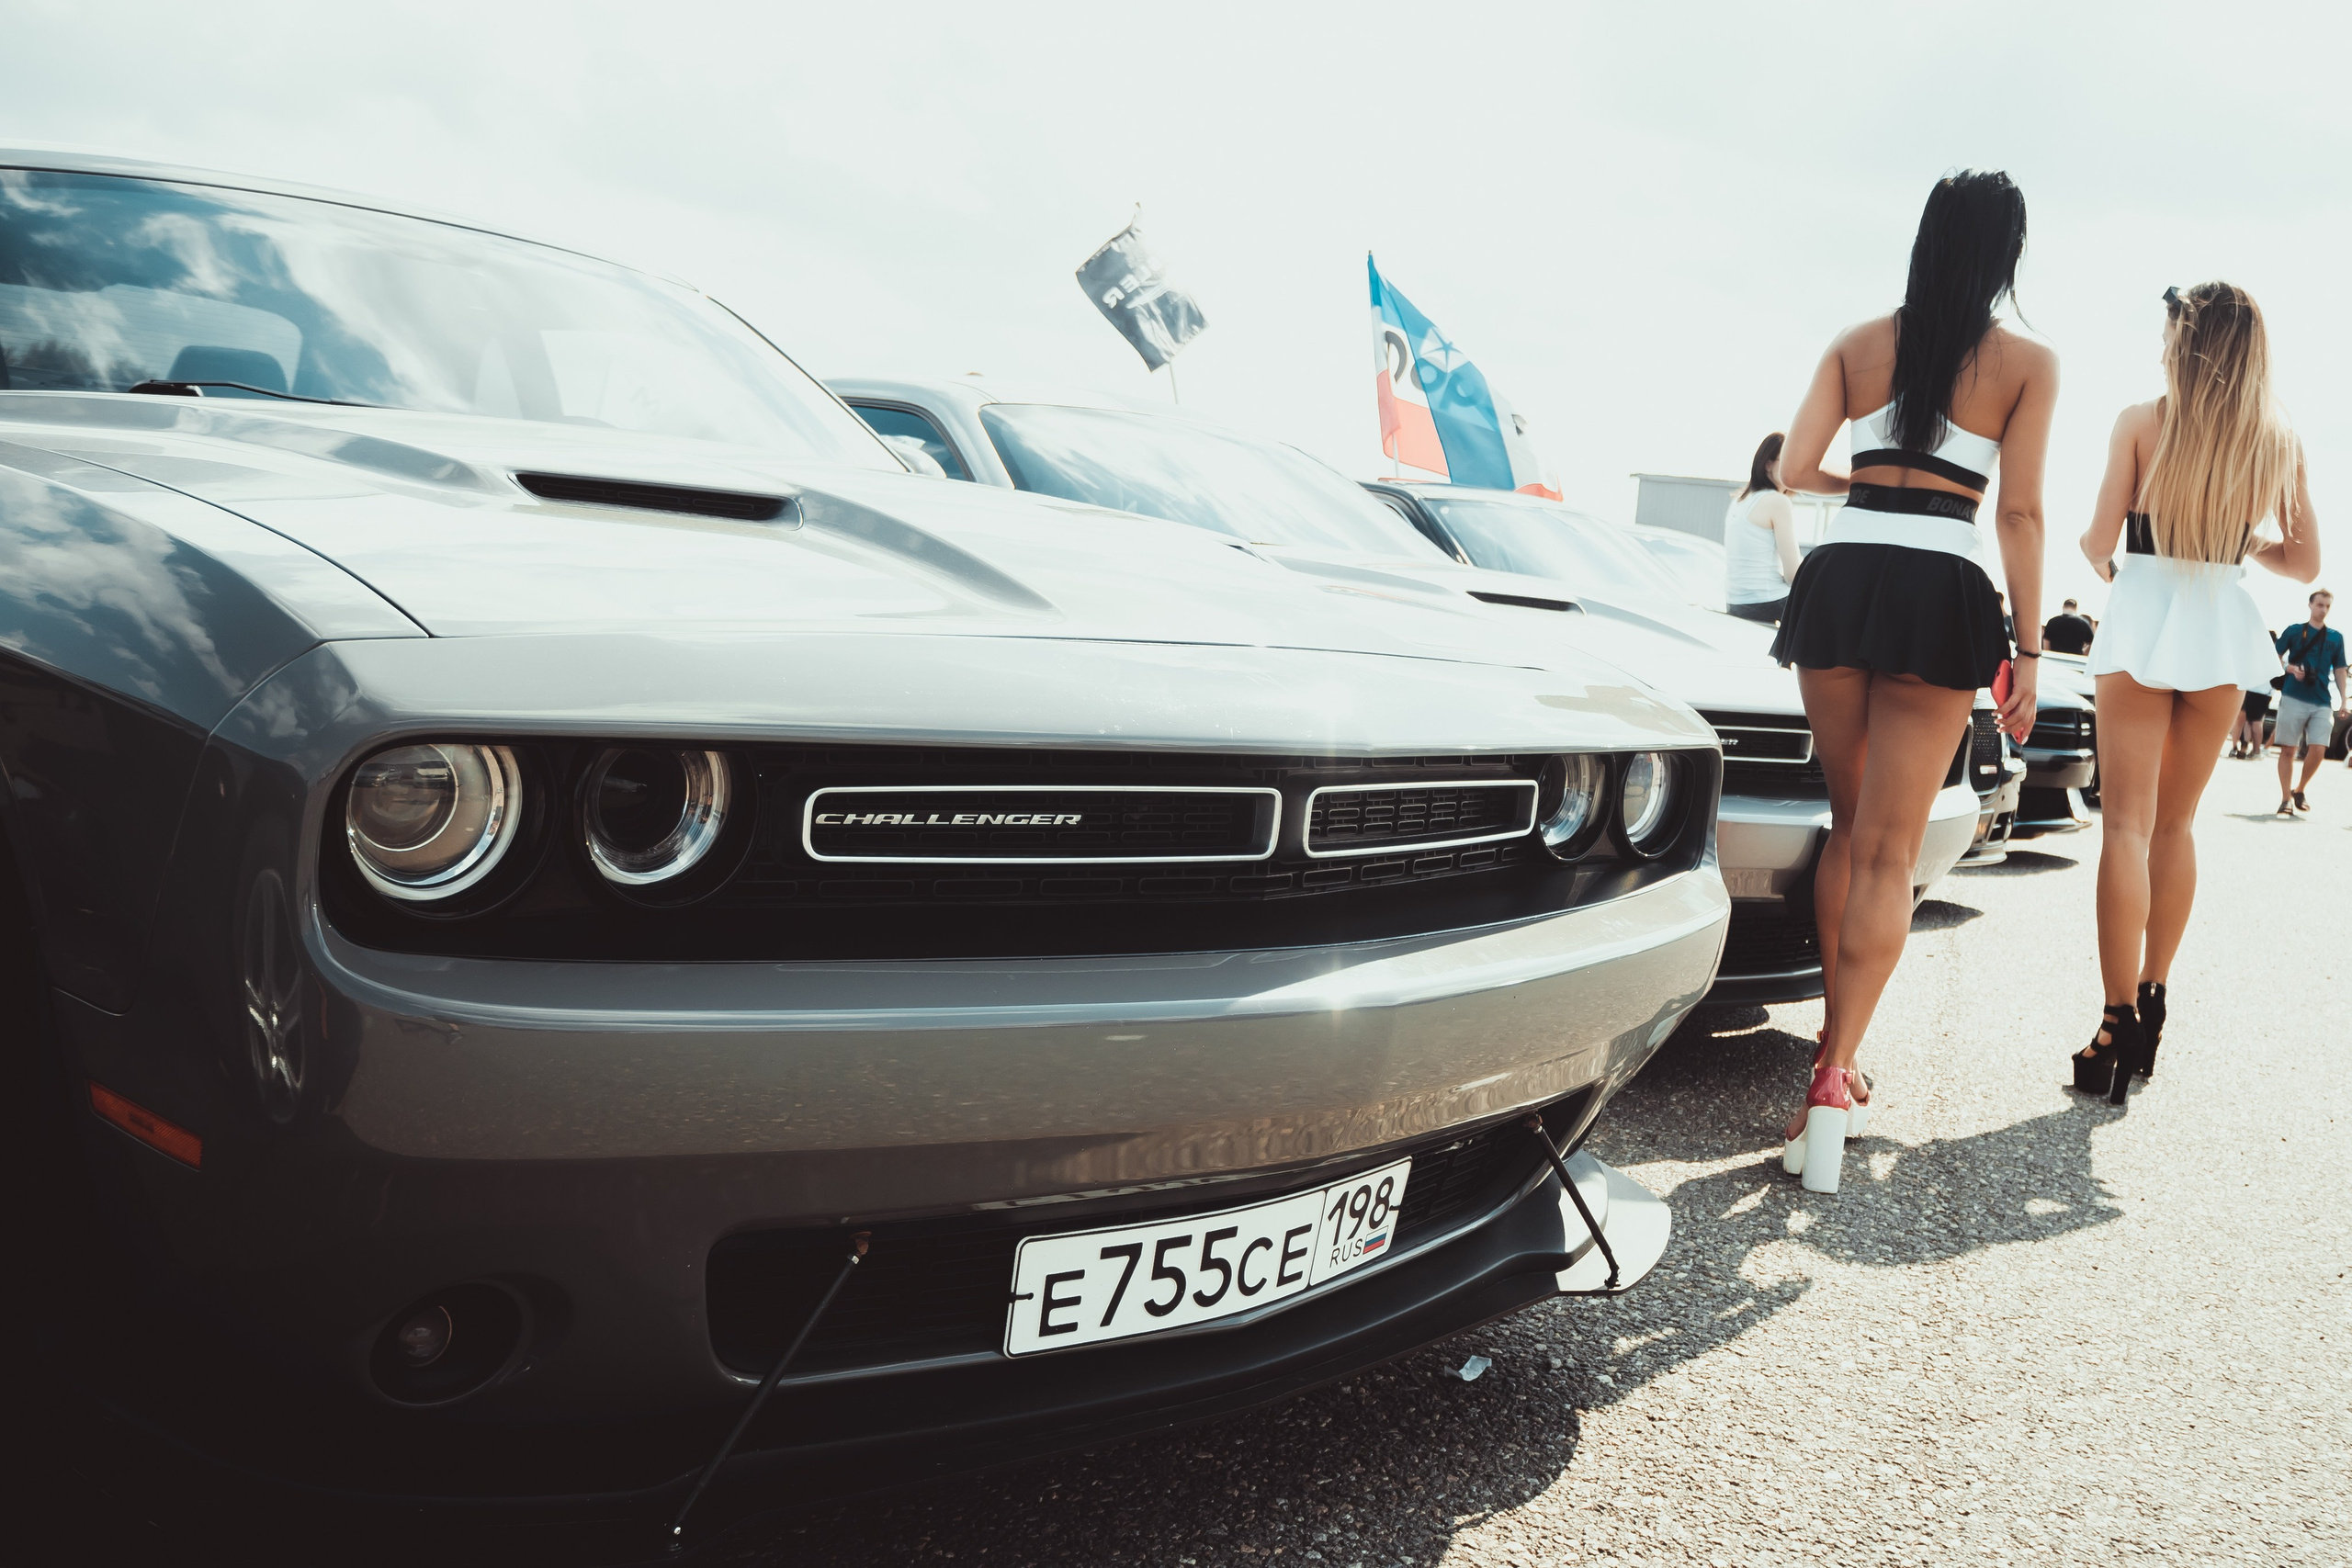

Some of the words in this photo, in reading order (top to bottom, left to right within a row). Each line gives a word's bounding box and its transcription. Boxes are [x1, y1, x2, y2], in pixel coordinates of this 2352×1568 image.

[815, 813, 1082, 825] CHALLENGER
[1328, 1176, 1395, 1246] 198
[1329, 1238, 1363, 1269] RUS
[1038, 1224, 1313, 1337] E755CE
